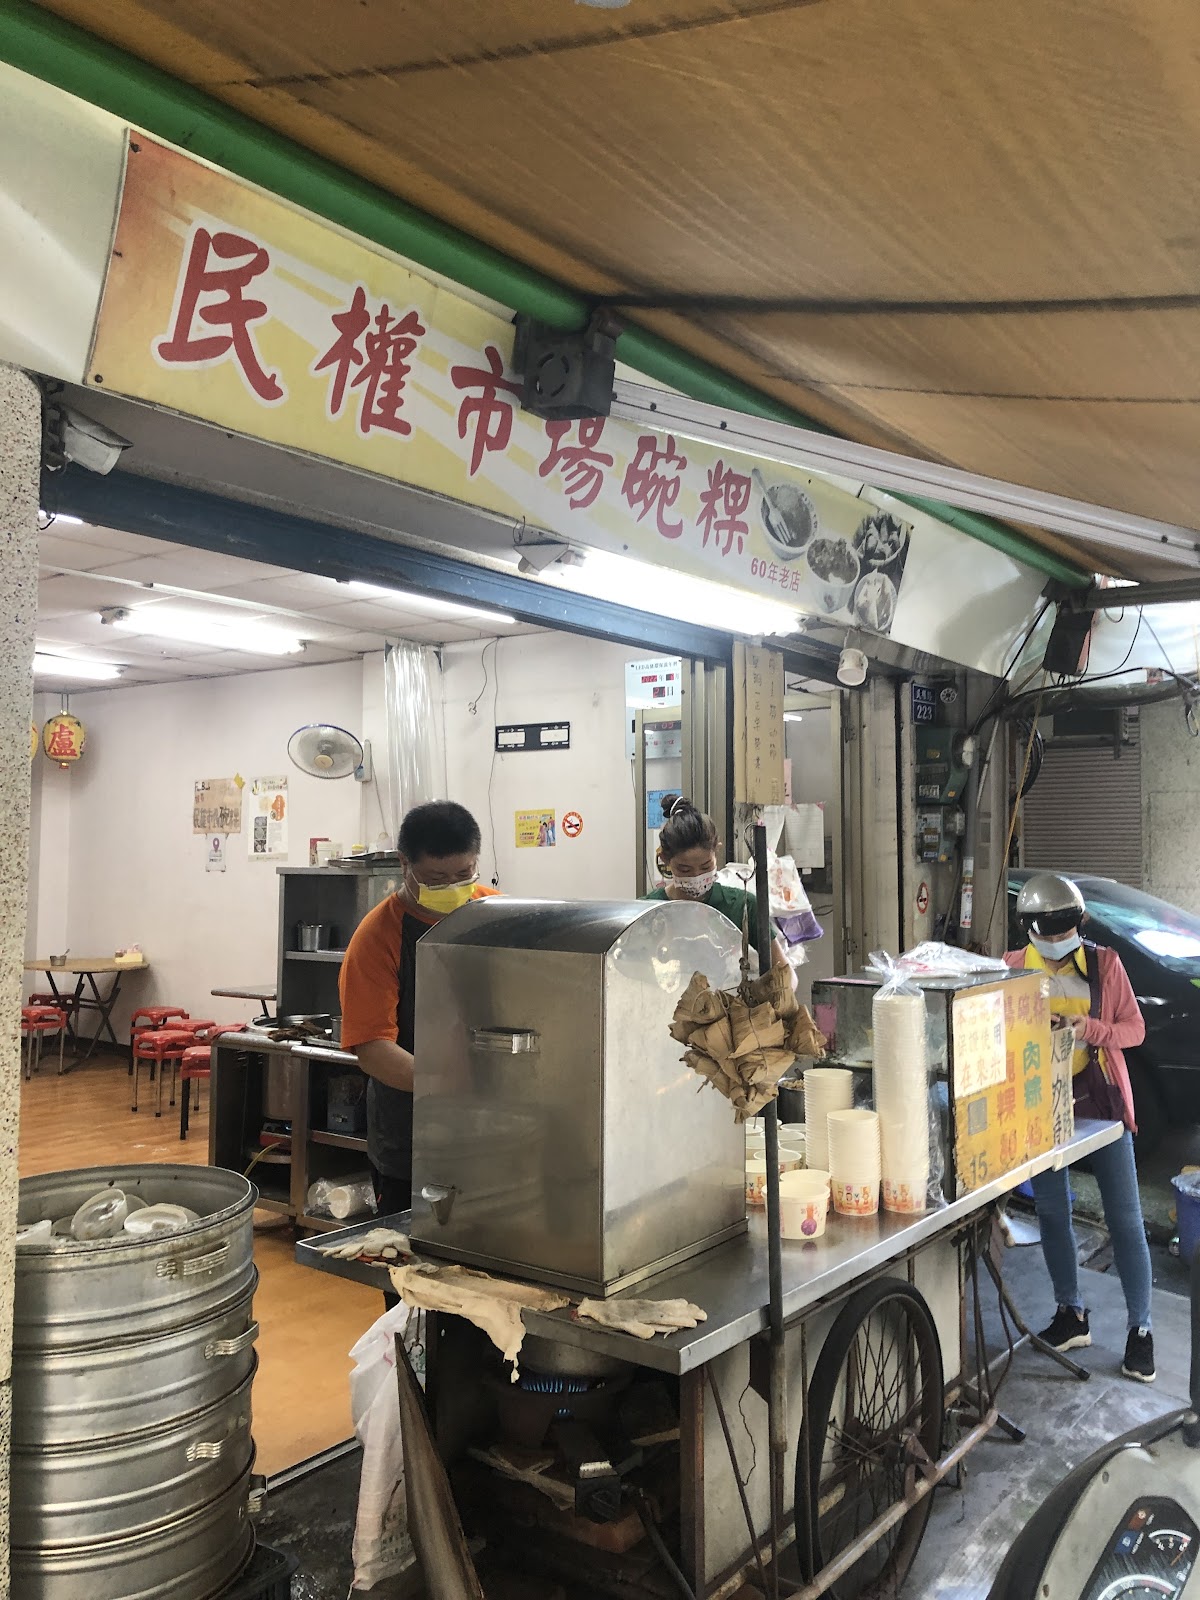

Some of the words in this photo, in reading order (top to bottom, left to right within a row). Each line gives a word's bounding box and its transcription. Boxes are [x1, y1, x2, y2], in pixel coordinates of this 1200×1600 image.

[157, 226, 752, 557] 民權市場碗粿
[751, 557, 801, 592] 60年老店
[916, 705, 933, 720] 223
[1022, 1040, 1043, 1110] 肉粽
[969, 1150, 988, 1186] 15
